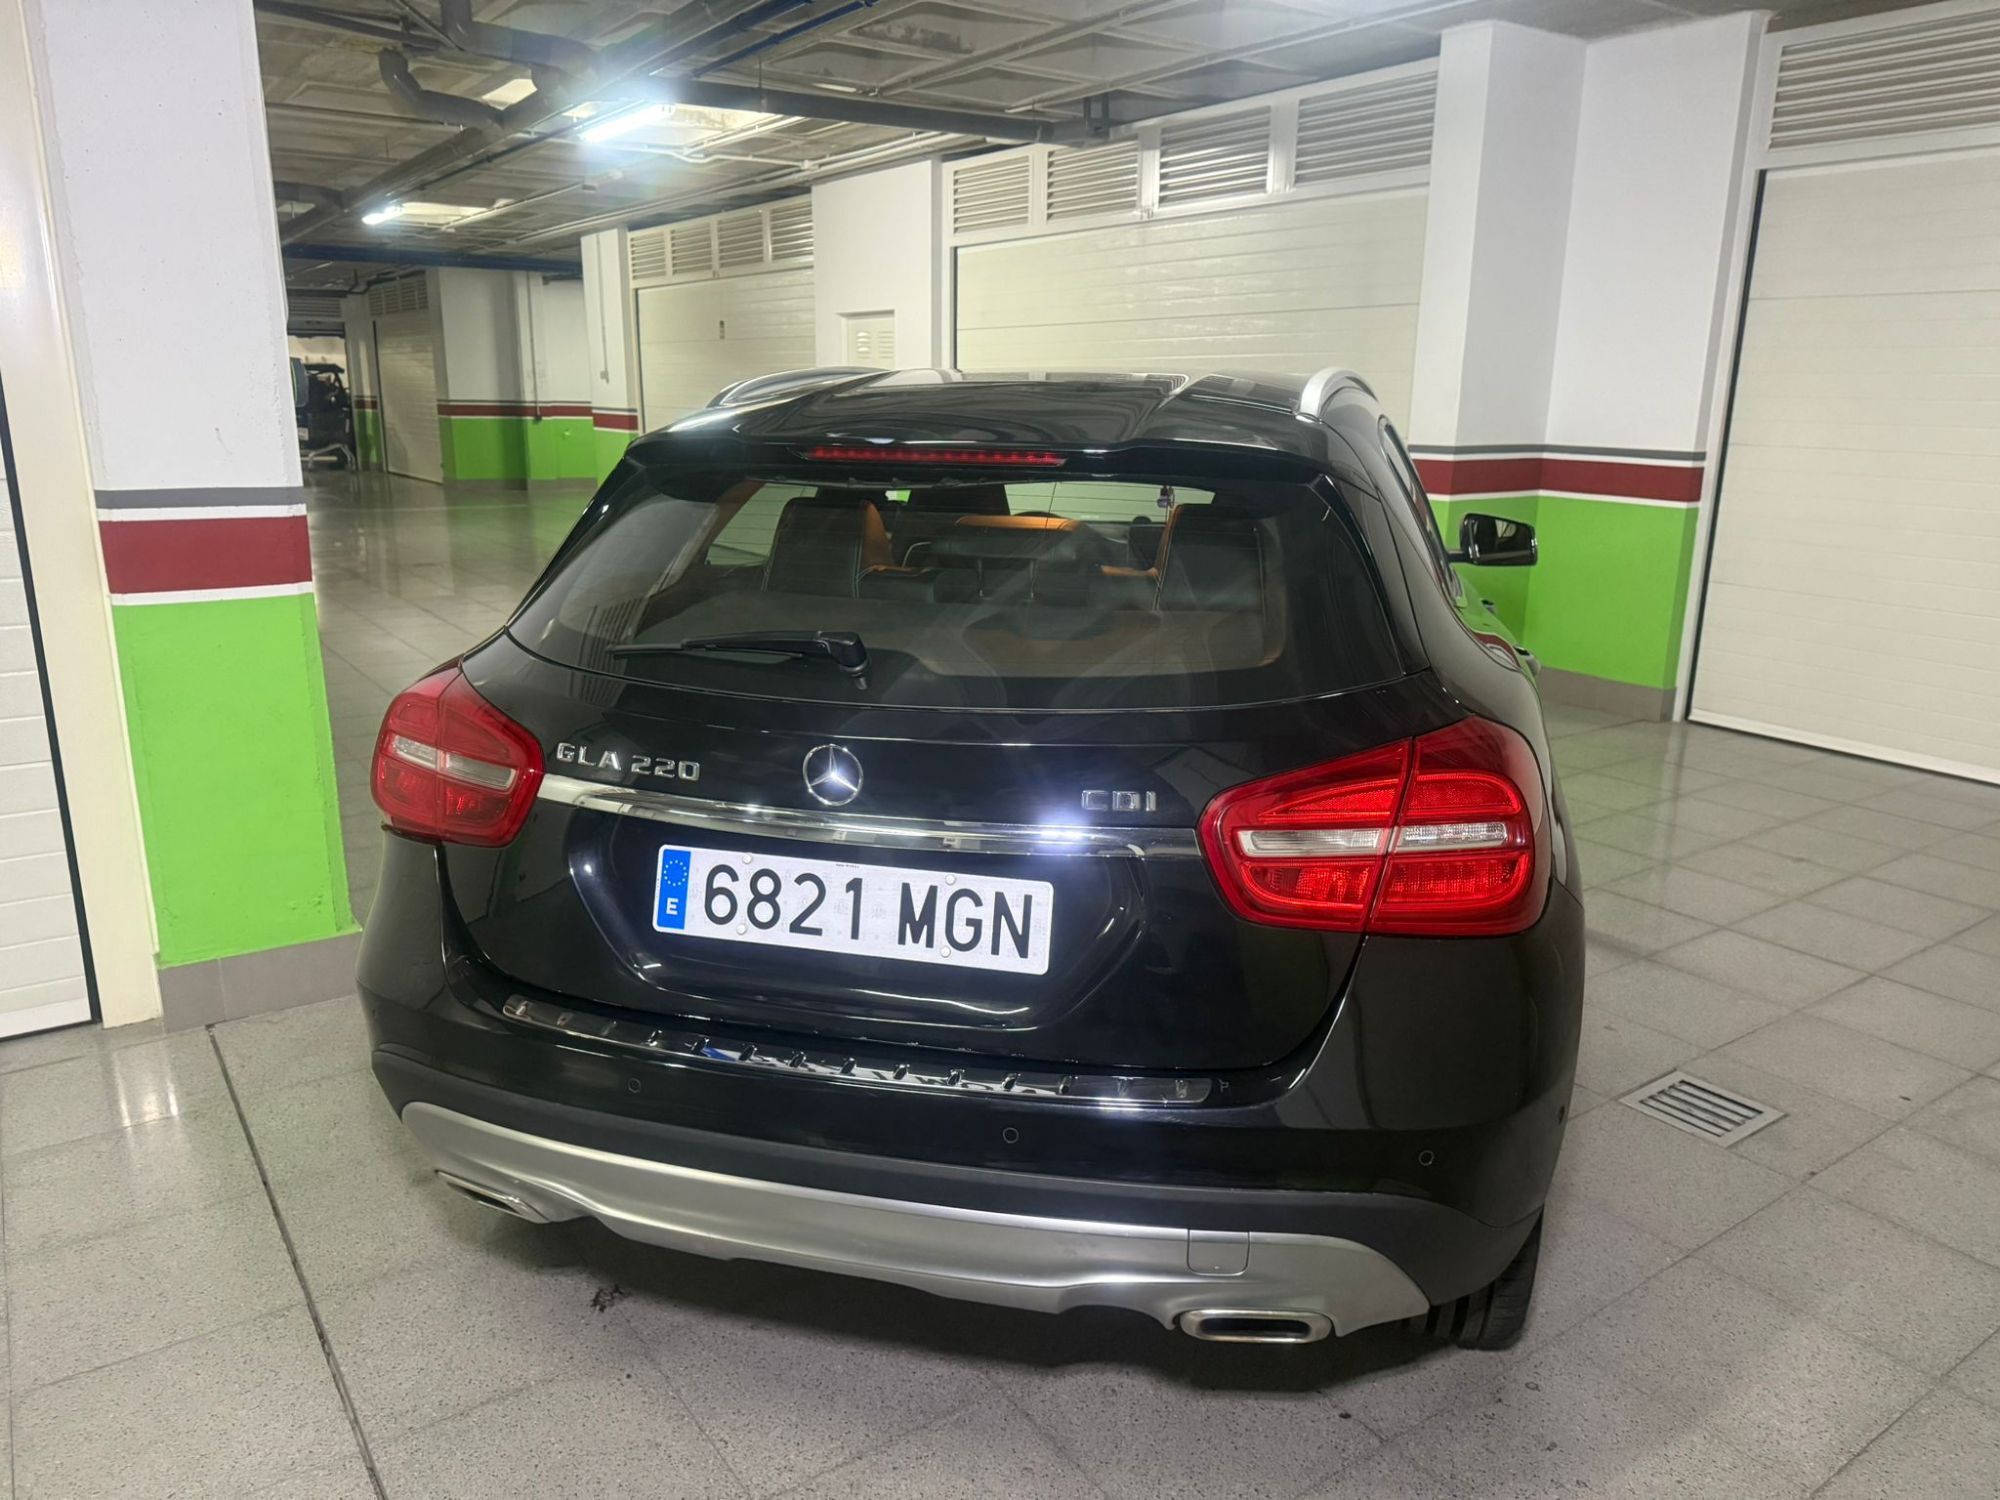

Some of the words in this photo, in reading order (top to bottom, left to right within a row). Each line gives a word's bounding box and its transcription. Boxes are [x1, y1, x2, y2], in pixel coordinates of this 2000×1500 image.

[556, 742, 621, 771] GLA
[631, 754, 701, 781] 220
[1081, 790, 1156, 811] CDI
[666, 897, 679, 915] E
[704, 864, 863, 941] 6821
[898, 882, 1033, 959] MGN
